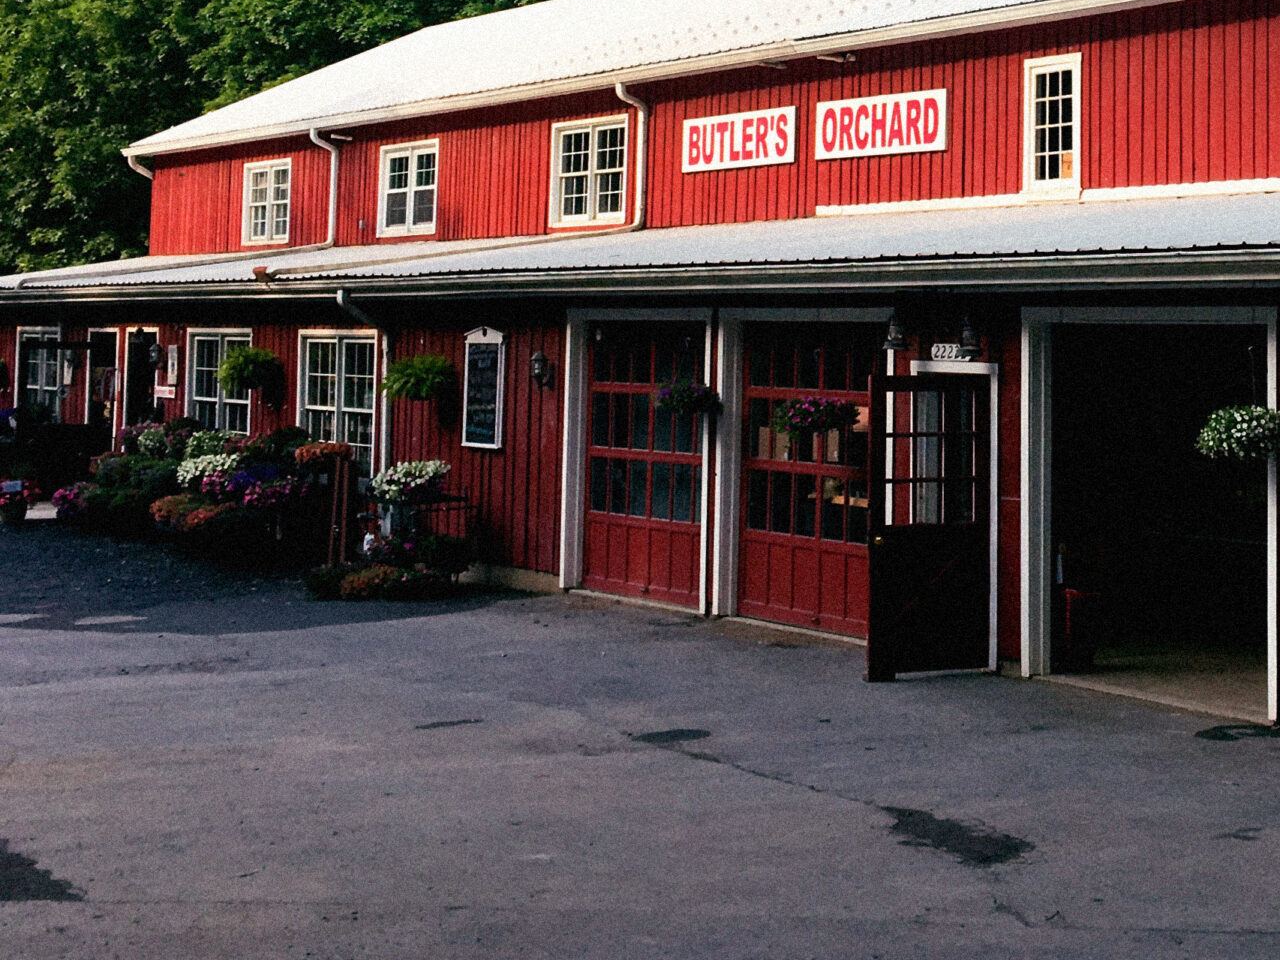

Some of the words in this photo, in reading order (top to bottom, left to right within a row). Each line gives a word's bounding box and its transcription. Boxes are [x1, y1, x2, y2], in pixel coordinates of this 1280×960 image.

[688, 113, 788, 166] BUTLER'S
[822, 98, 939, 152] ORCHARD
[934, 344, 966, 359] 2222
